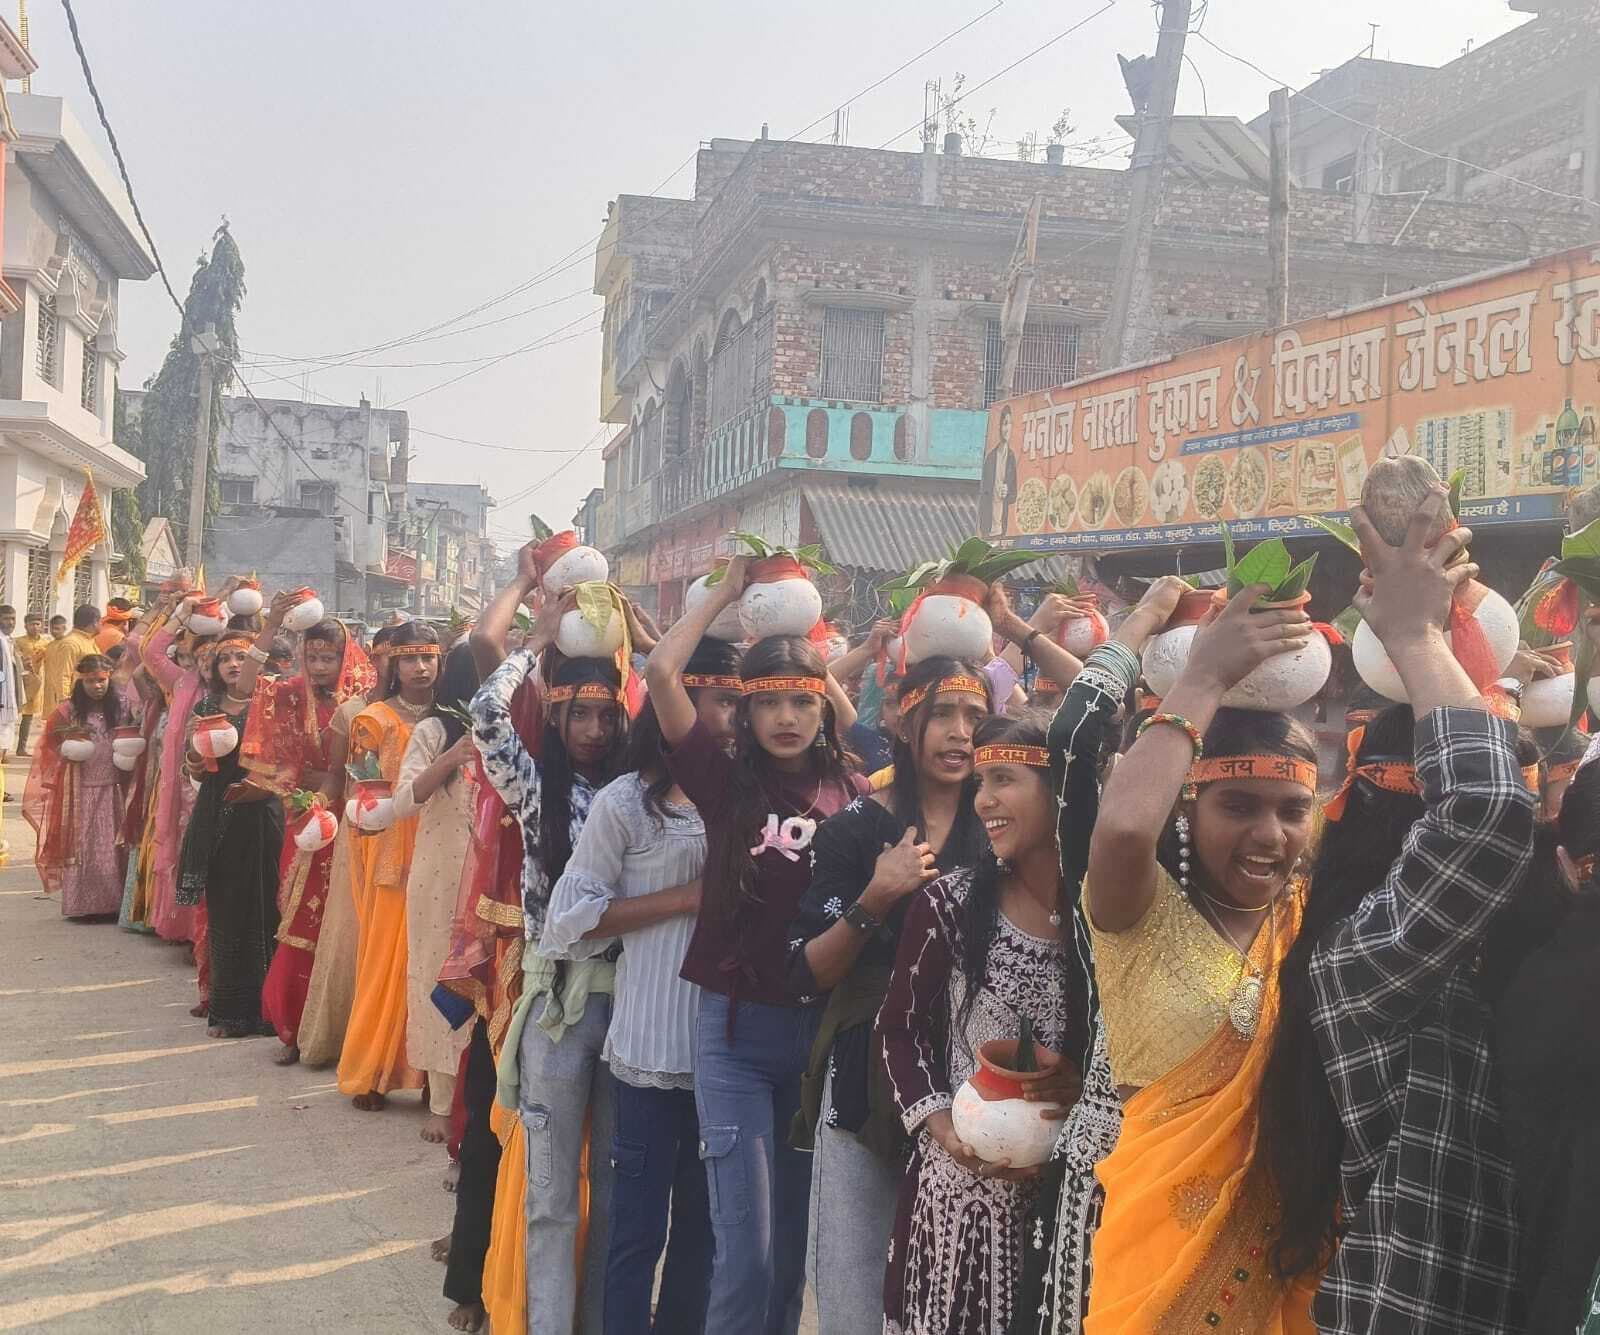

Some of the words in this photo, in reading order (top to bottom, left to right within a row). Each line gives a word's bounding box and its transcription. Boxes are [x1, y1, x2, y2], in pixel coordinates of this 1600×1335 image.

[1023, 391, 1077, 461] मनोज
[1146, 367, 1221, 462] दुकान
[1231, 355, 1262, 426] &
[1271, 329, 1386, 417] विकाश
[1396, 298, 1538, 392] जेनरल
[997, 749, 1027, 761] राम
[1219, 758, 1256, 776] जय
[1271, 758, 1299, 779] श्री
